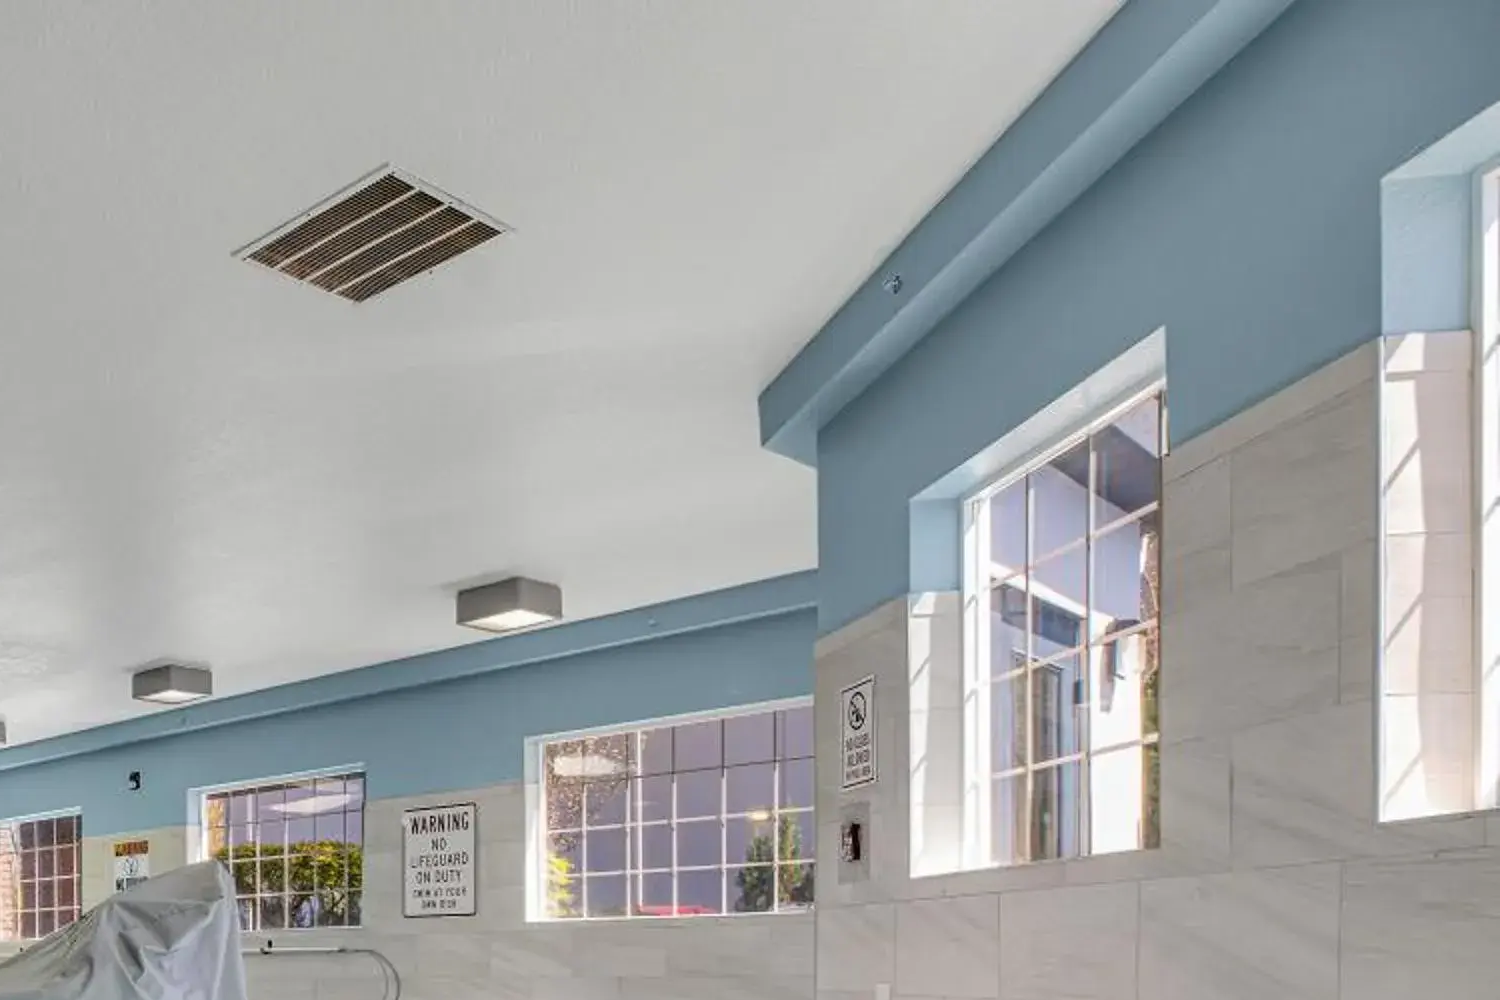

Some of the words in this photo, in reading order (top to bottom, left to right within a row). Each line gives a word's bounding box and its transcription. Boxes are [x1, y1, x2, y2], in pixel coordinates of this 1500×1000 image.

[411, 812, 469, 835] WARNING
[431, 837, 448, 851] NO
[415, 871, 431, 885] ON
[435, 869, 462, 884] DUTY
